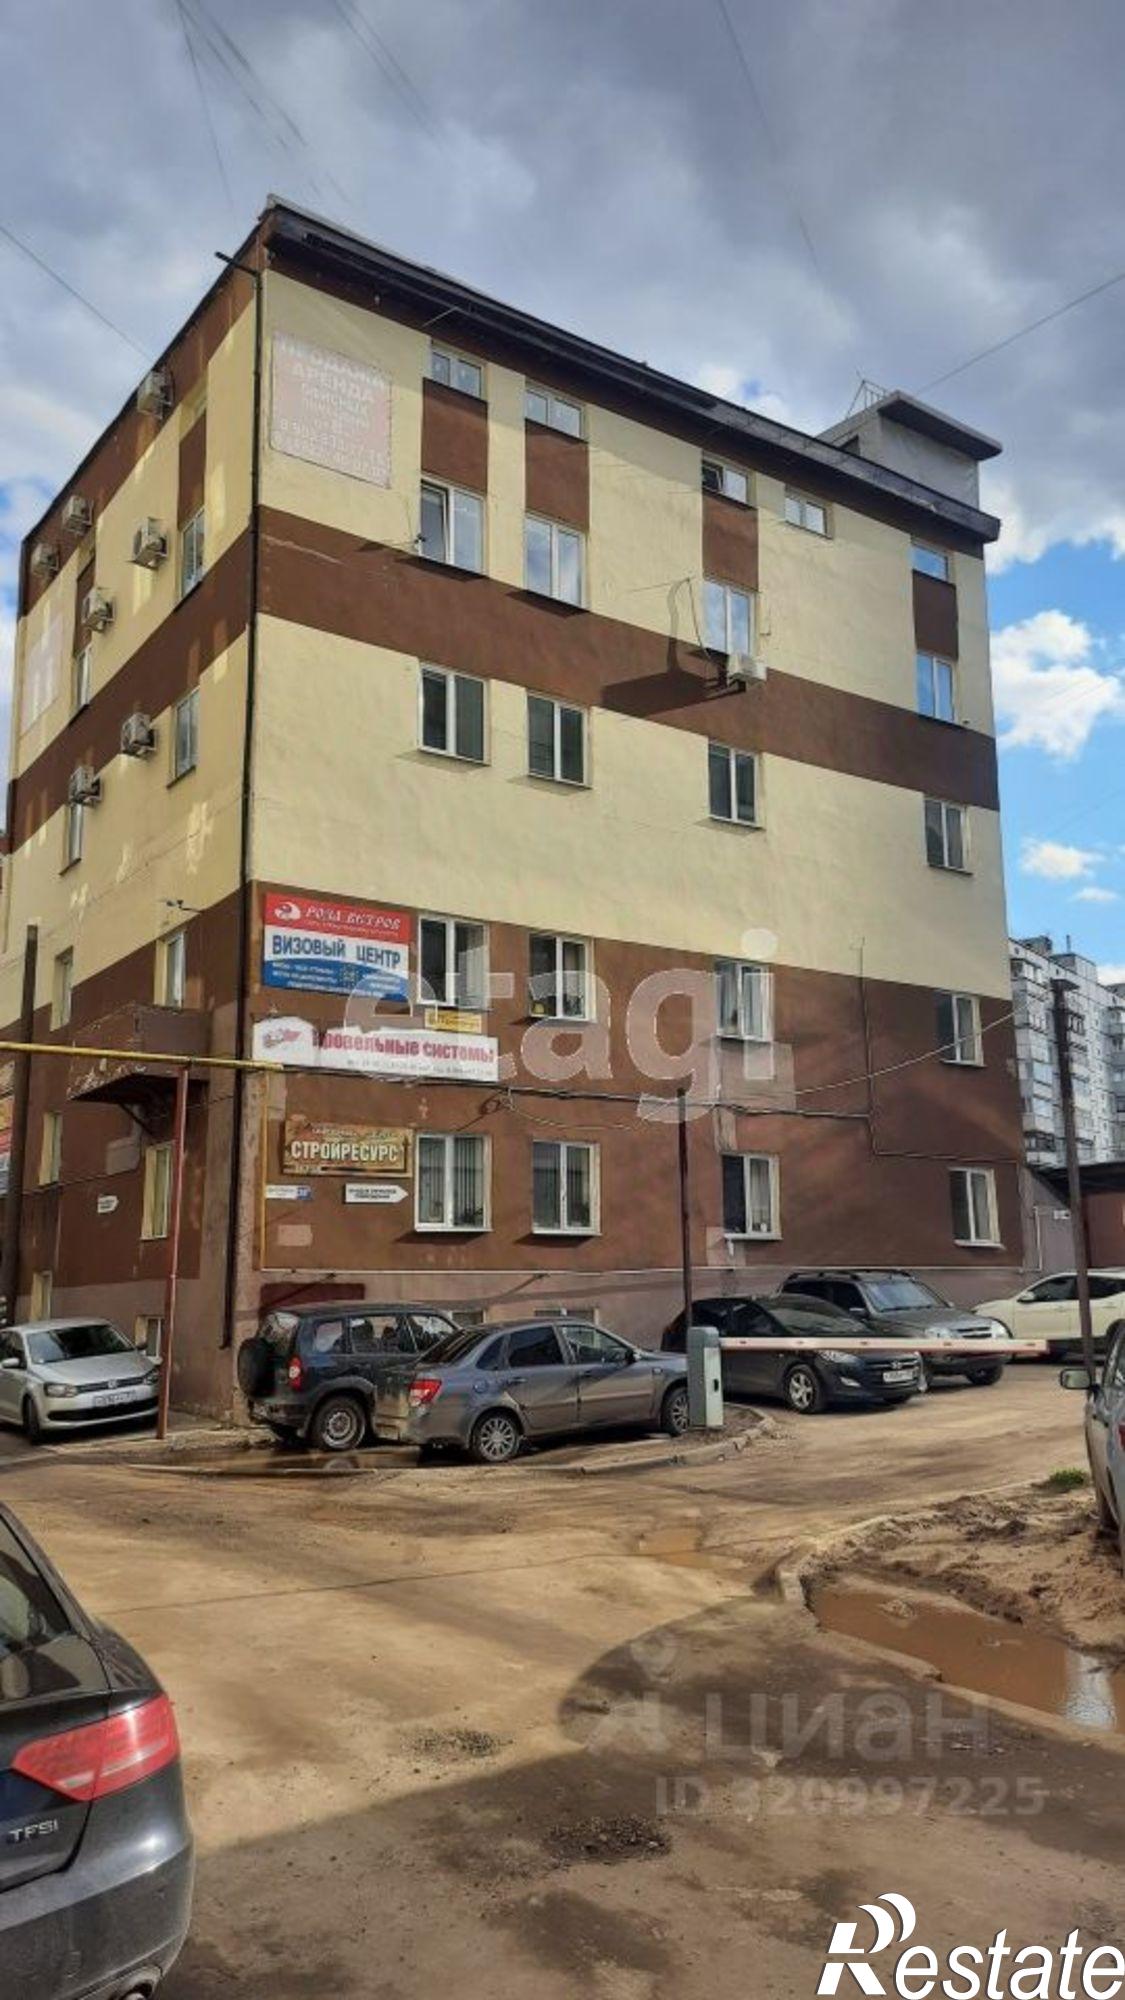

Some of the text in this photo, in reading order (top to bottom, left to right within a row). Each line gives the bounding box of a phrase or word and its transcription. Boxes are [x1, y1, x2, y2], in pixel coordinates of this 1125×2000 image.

[272, 934, 401, 969] ВИЗОВЫЙ ЦЕНТР
[291, 1140, 399, 1162] СТРОЙРЕСУРС
[8, 1819, 59, 1842] TFSI
